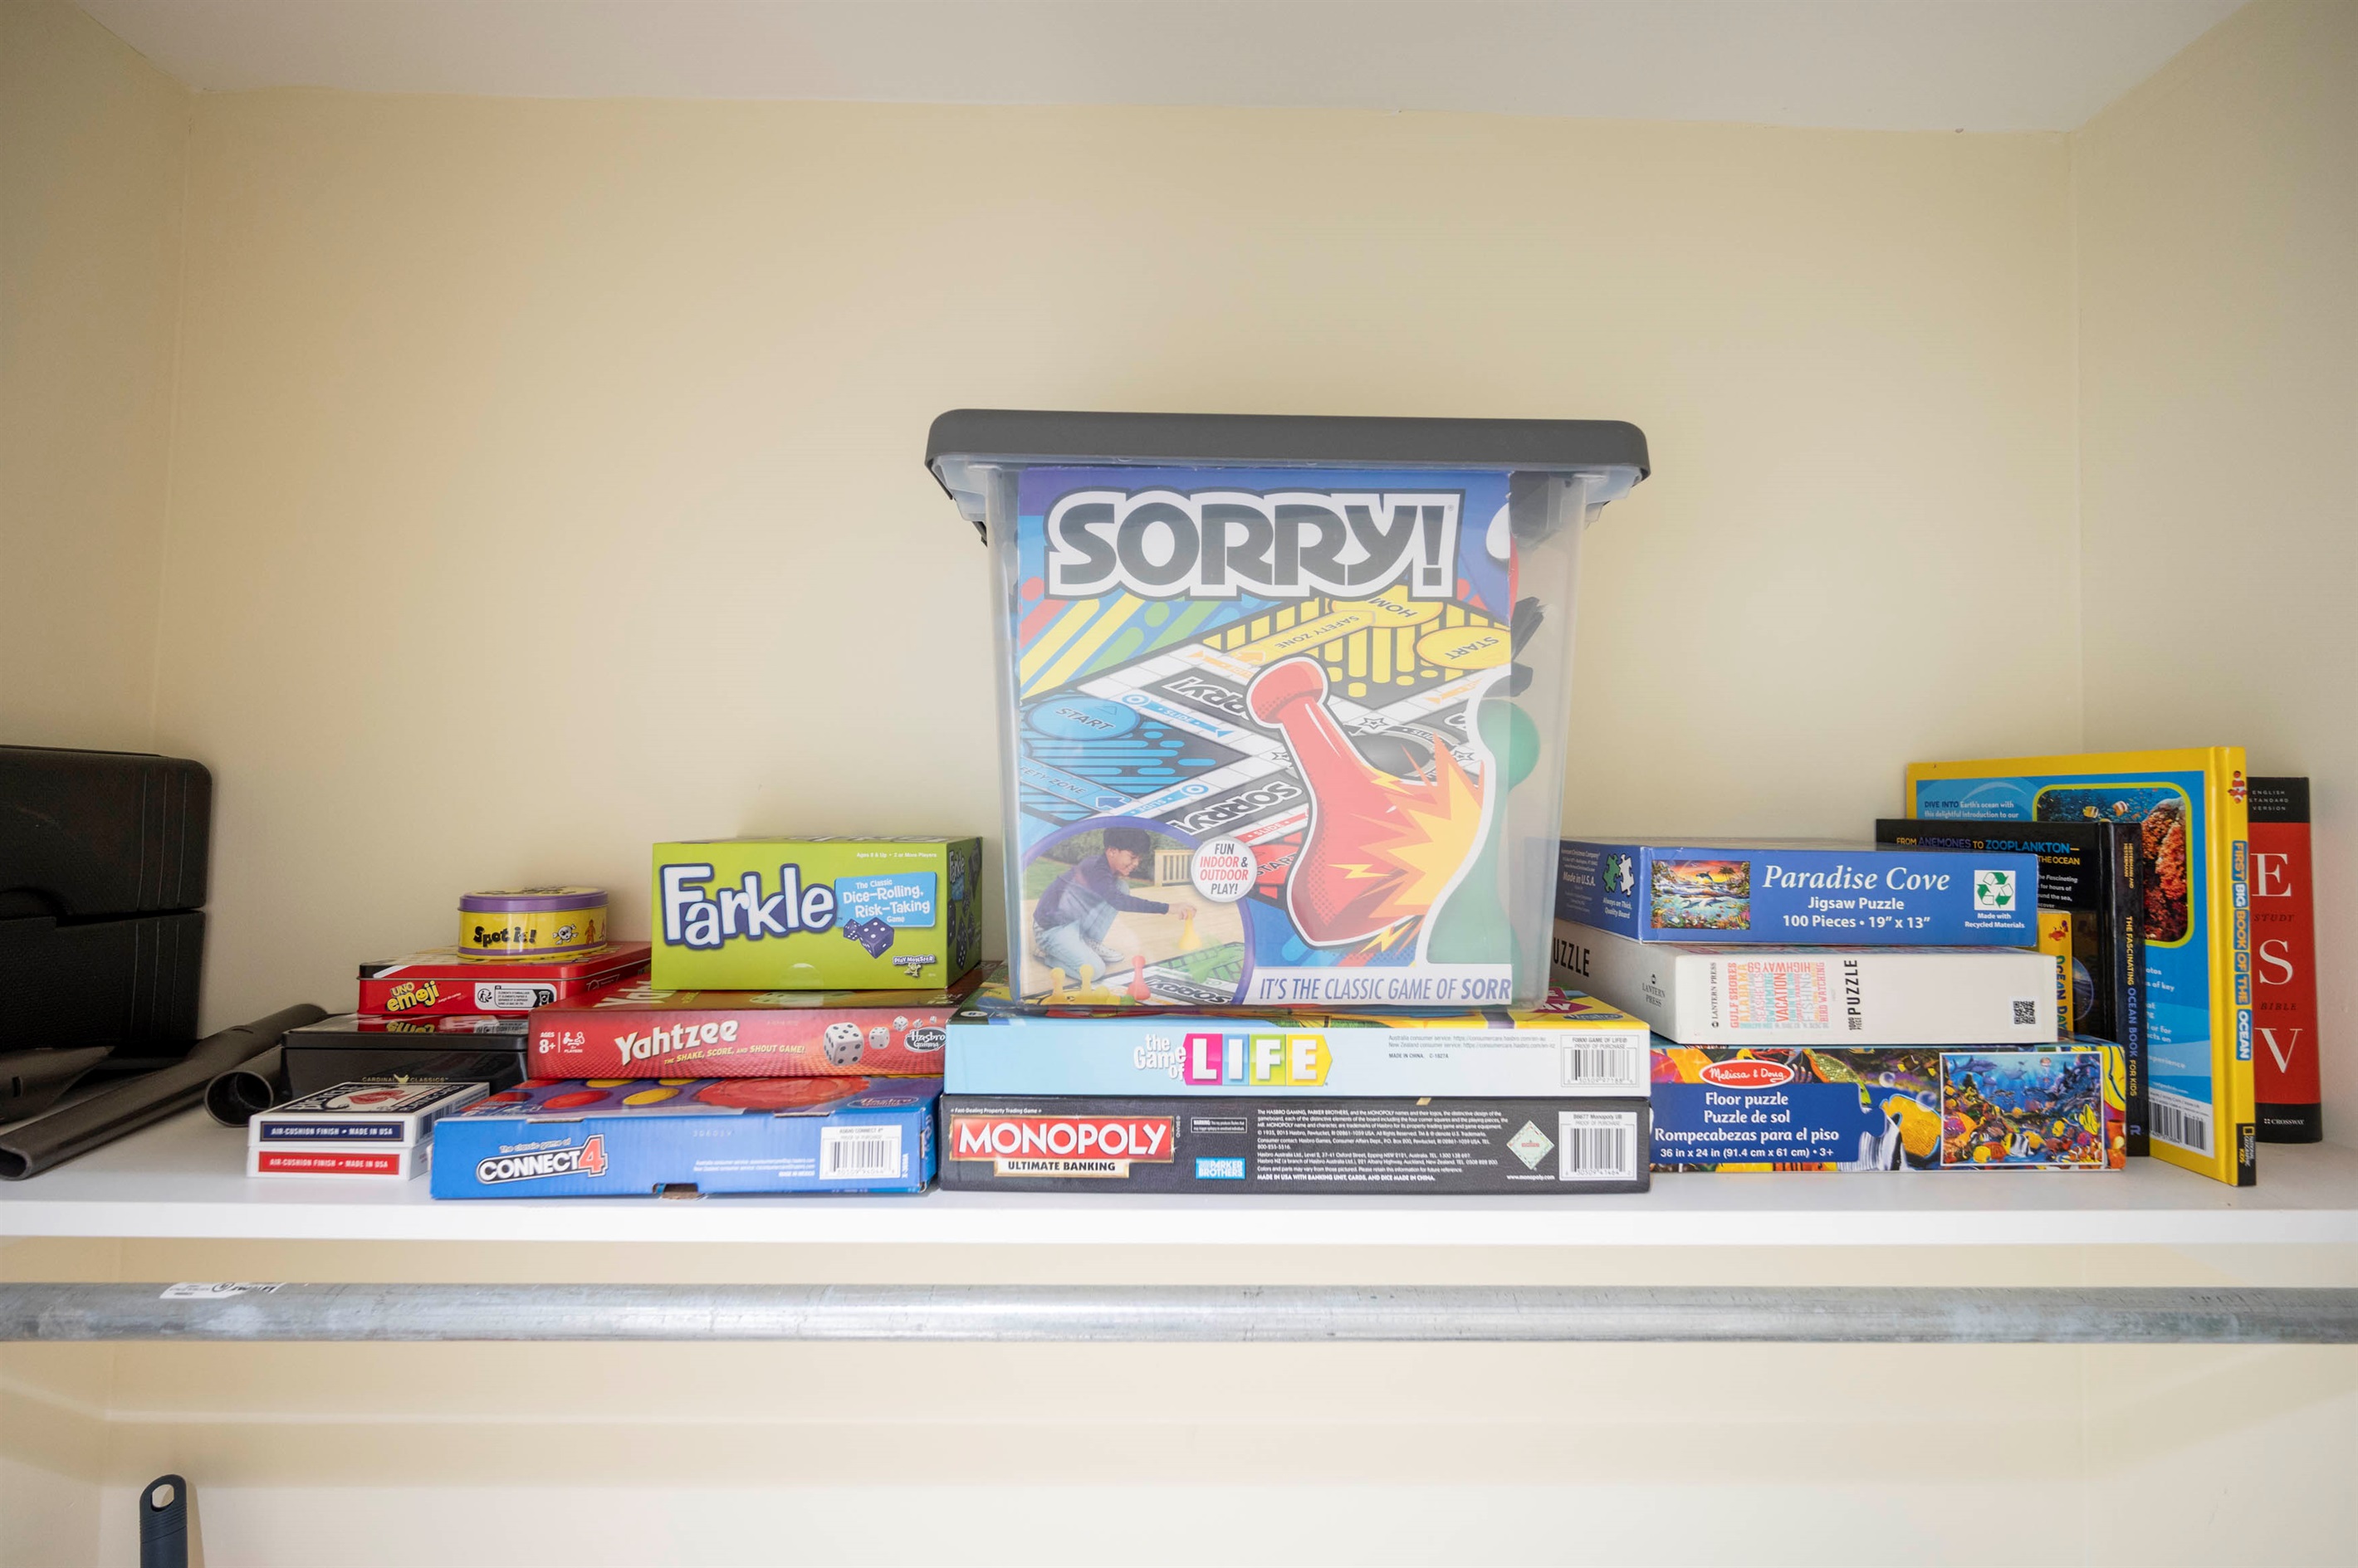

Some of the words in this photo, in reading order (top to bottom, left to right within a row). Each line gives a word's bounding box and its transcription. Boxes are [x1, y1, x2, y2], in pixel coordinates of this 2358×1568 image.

[1049, 493, 1455, 594] SORRY!
[1314, 616, 1359, 636] SAFETY
[1274, 634, 1313, 650] ZONE
[1445, 637, 1499, 660] START
[1056, 708, 1116, 731] START
[1163, 709, 1194, 724] SLIDE
[1167, 781, 1302, 834] SORRY!
[1935, 810, 1961, 818] delightful
[1215, 843, 1234, 854] FUN
[1896, 837, 1917, 845] FROM
[1919, 837, 1972, 848] ANEMONES
[1973, 840, 1984, 849] TO
[1200, 856, 1239, 867] INDOOR
[1241, 857, 1248, 867] &
[2052, 856, 2081, 865] OCEAN
[2234, 842, 2245, 880] FIRST
[870, 879, 893, 888] Classic
[1200, 869, 1249, 881] OUTDOOR
[1763, 865, 1877, 891] Paradise
[1886, 867, 1950, 891] Cove
[2250, 852, 2291, 896] E
[1211, 883, 1238, 895] PLAY!
[2235, 883, 2246, 907] BIG
[661, 864, 835, 947] Farkle
[854, 901, 930, 918] Risk-Taking
[1808, 896, 1855, 911] Jigsaw
[1859, 898, 1905, 910] Puzzle
[1783, 915, 1808, 926] 100
[1813, 915, 1857, 928] Pieces
[1895, 920, 1903, 928] x
[1964, 921, 1993, 929] Recycled
[2237, 911, 2248, 949] BOOK
[473, 926, 509, 947] Spot
[513, 926, 536, 944] it!
[1553, 937, 1590, 977] UZZLE
[1748, 962, 1761, 972] 59
[2126, 931, 2135, 985] FASCINATING
[2237, 952, 2248, 971] OF
[2258, 940, 2293, 985] S
[1763, 962, 1811, 973] HIGHWAY
[391, 982, 414, 996] UNO
[1260, 979, 1287, 999] IT'S
[1293, 979, 1320, 999] THE
[1325, 979, 1385, 999] CLASSIC
[1388, 979, 1432, 999] GAME
[1436, 979, 1456, 999] OF
[1728, 962, 1738, 1000] SHORES
[1817, 962, 1827, 1002] WATCHING
[1844, 960, 1861, 1015] PUZZLE
[2055, 955, 2066, 1003] OCEAN
[386, 980, 440, 1011] emoji
[1642, 983, 1666, 998] LANTERN
[1738, 964, 1750, 1022] ALABAMA
[1773, 973, 1788, 1022] VACATION
[1800, 973, 1814, 1022] FISHING
[2237, 975, 2248, 1004] THE
[1646, 995, 1662, 1007] PRESS
[1710, 985, 1719, 1019] LANTERN
[2127, 987, 2136, 1024] OCEAN
[2260, 1002, 2297, 1010] BIBLE
[1729, 1002, 1739, 1028] GULF
[1819, 1003, 1829, 1022] BIRD
[614, 1020, 739, 1066] Yahtzee
[907, 1031, 945, 1043] Hasbro
[1145, 1033, 1171, 1052] the
[2129, 1027, 2137, 1057] BOOK
[2238, 1010, 2249, 1059] OCEAN
[539, 1039, 555, 1053] 8+
[677, 1052, 705, 1062] SHAKE,
[707, 1048, 735, 1057] SCORE,
[750, 1044, 777, 1053] SHOUT
[779, 1045, 805, 1053] GAME!
[2254, 1028, 2302, 1073] V
[1133, 1046, 1186, 1070] Game
[1192, 1038, 1317, 1080] LIFE
[1168, 1063, 1185, 1081] of
[1710, 1068, 1751, 1082] Melissa
[1761, 1069, 1786, 1082] Doug
[1705, 1092, 1742, 1105] Floor
[1745, 1092, 1789, 1108] puzzle
[1704, 1110, 1747, 1123] Puzzle
[1751, 1110, 1768, 1123] de
[1770, 1110, 1790, 1123] sol
[959, 1122, 1167, 1155] MONOPOLY
[1655, 1128, 1757, 1144] Rompecabezas
[1760, 1131, 1793, 1144] para
[1796, 1129, 1808, 1141] el
[1811, 1128, 1840, 1144] piso
[479, 1150, 580, 1180] CONNECT
[579, 1138, 604, 1173] 4
[1661, 1149, 1673, 1157] 36
[1676, 1149, 1685, 1157] in
[1695, 1149, 1709, 1157] 24
[1710, 1149, 1720, 1157] in
[1723, 1148, 1748, 1159] (91.4
[1776, 1149, 1788, 1157] 61
[1790, 1148, 1810, 1159] cm)
[1819, 1149, 1834, 1157] 3+
[1008, 1160, 1060, 1171] ULTIMATE
[1064, 1161, 1116, 1171] BANKING
[1198, 1169, 1243, 1178] BROTHERS
[1210, 1160, 1243, 1170] PARKER
